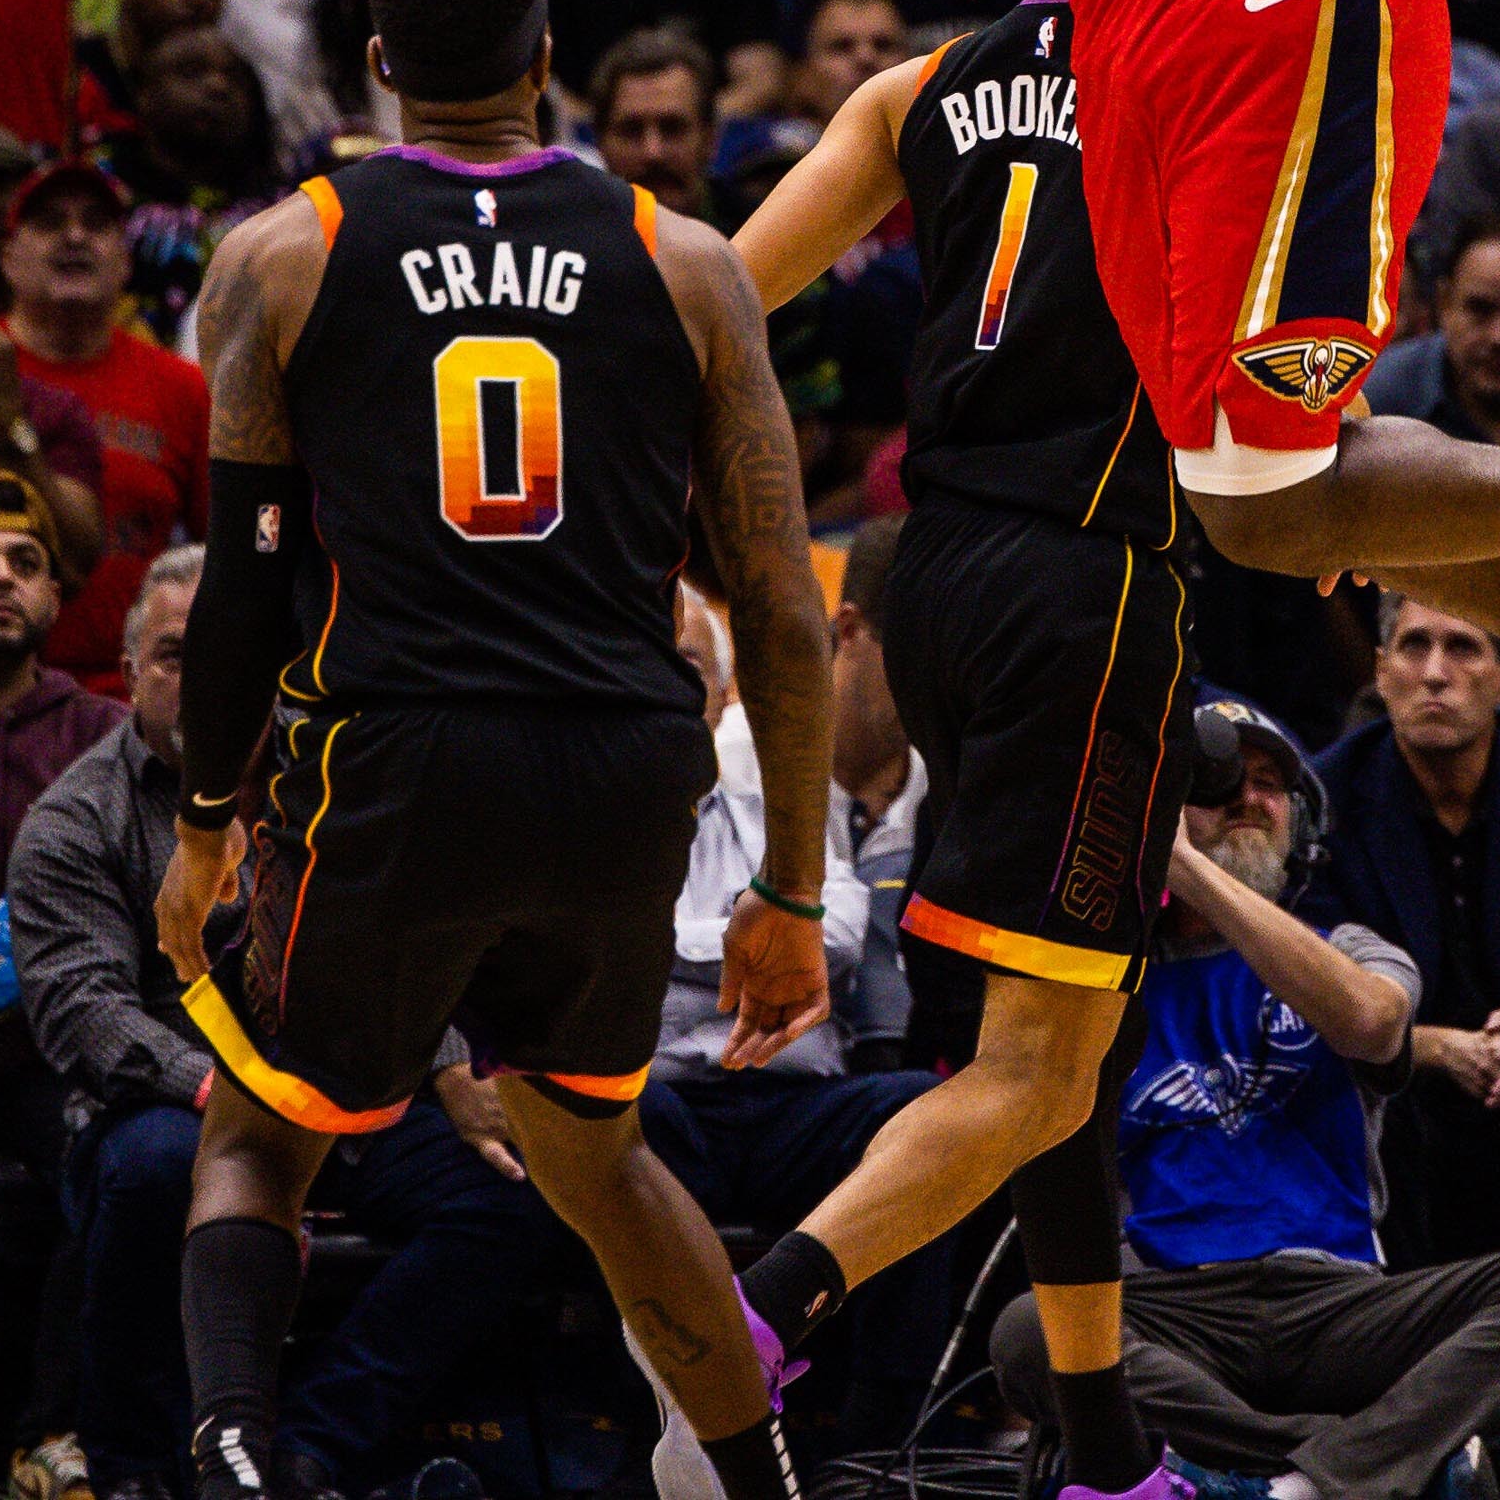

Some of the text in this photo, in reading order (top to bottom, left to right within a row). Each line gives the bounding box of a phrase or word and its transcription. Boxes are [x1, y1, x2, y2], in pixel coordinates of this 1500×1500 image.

[400, 242, 587, 315] CRAIG
[975, 162, 1039, 351] 1
[433, 336, 564, 542] 0
